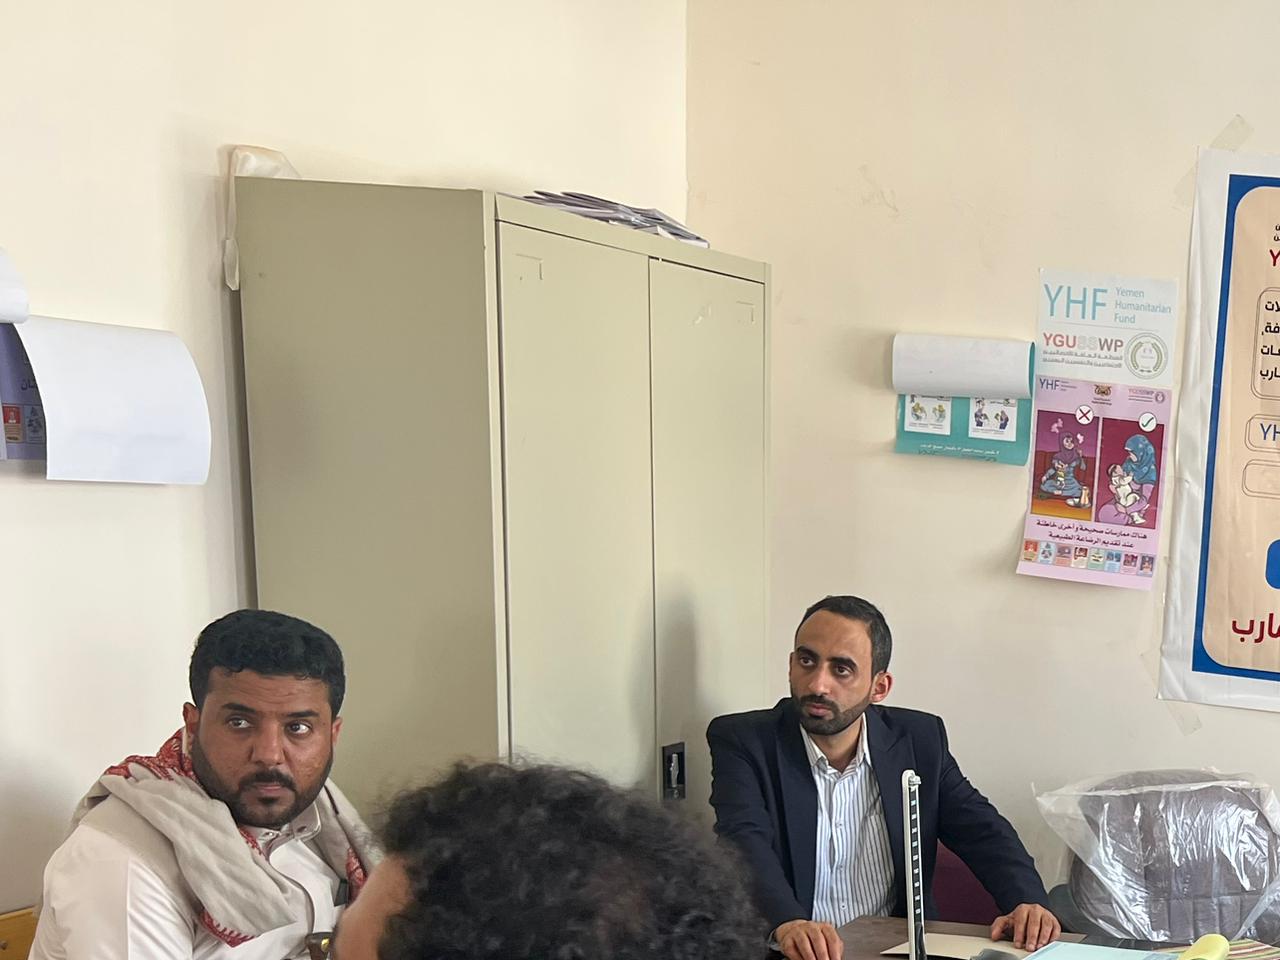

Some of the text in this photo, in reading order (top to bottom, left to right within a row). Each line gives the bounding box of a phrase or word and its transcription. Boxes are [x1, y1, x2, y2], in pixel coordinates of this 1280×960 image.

[1115, 287, 1145, 298] Yemen
[1043, 283, 1109, 321] YHF
[1114, 300, 1172, 314] Humanitarian
[1113, 313, 1136, 324] Fund
[1042, 331, 1125, 353] YGUSSWP
[1039, 378, 1060, 391] YHF
